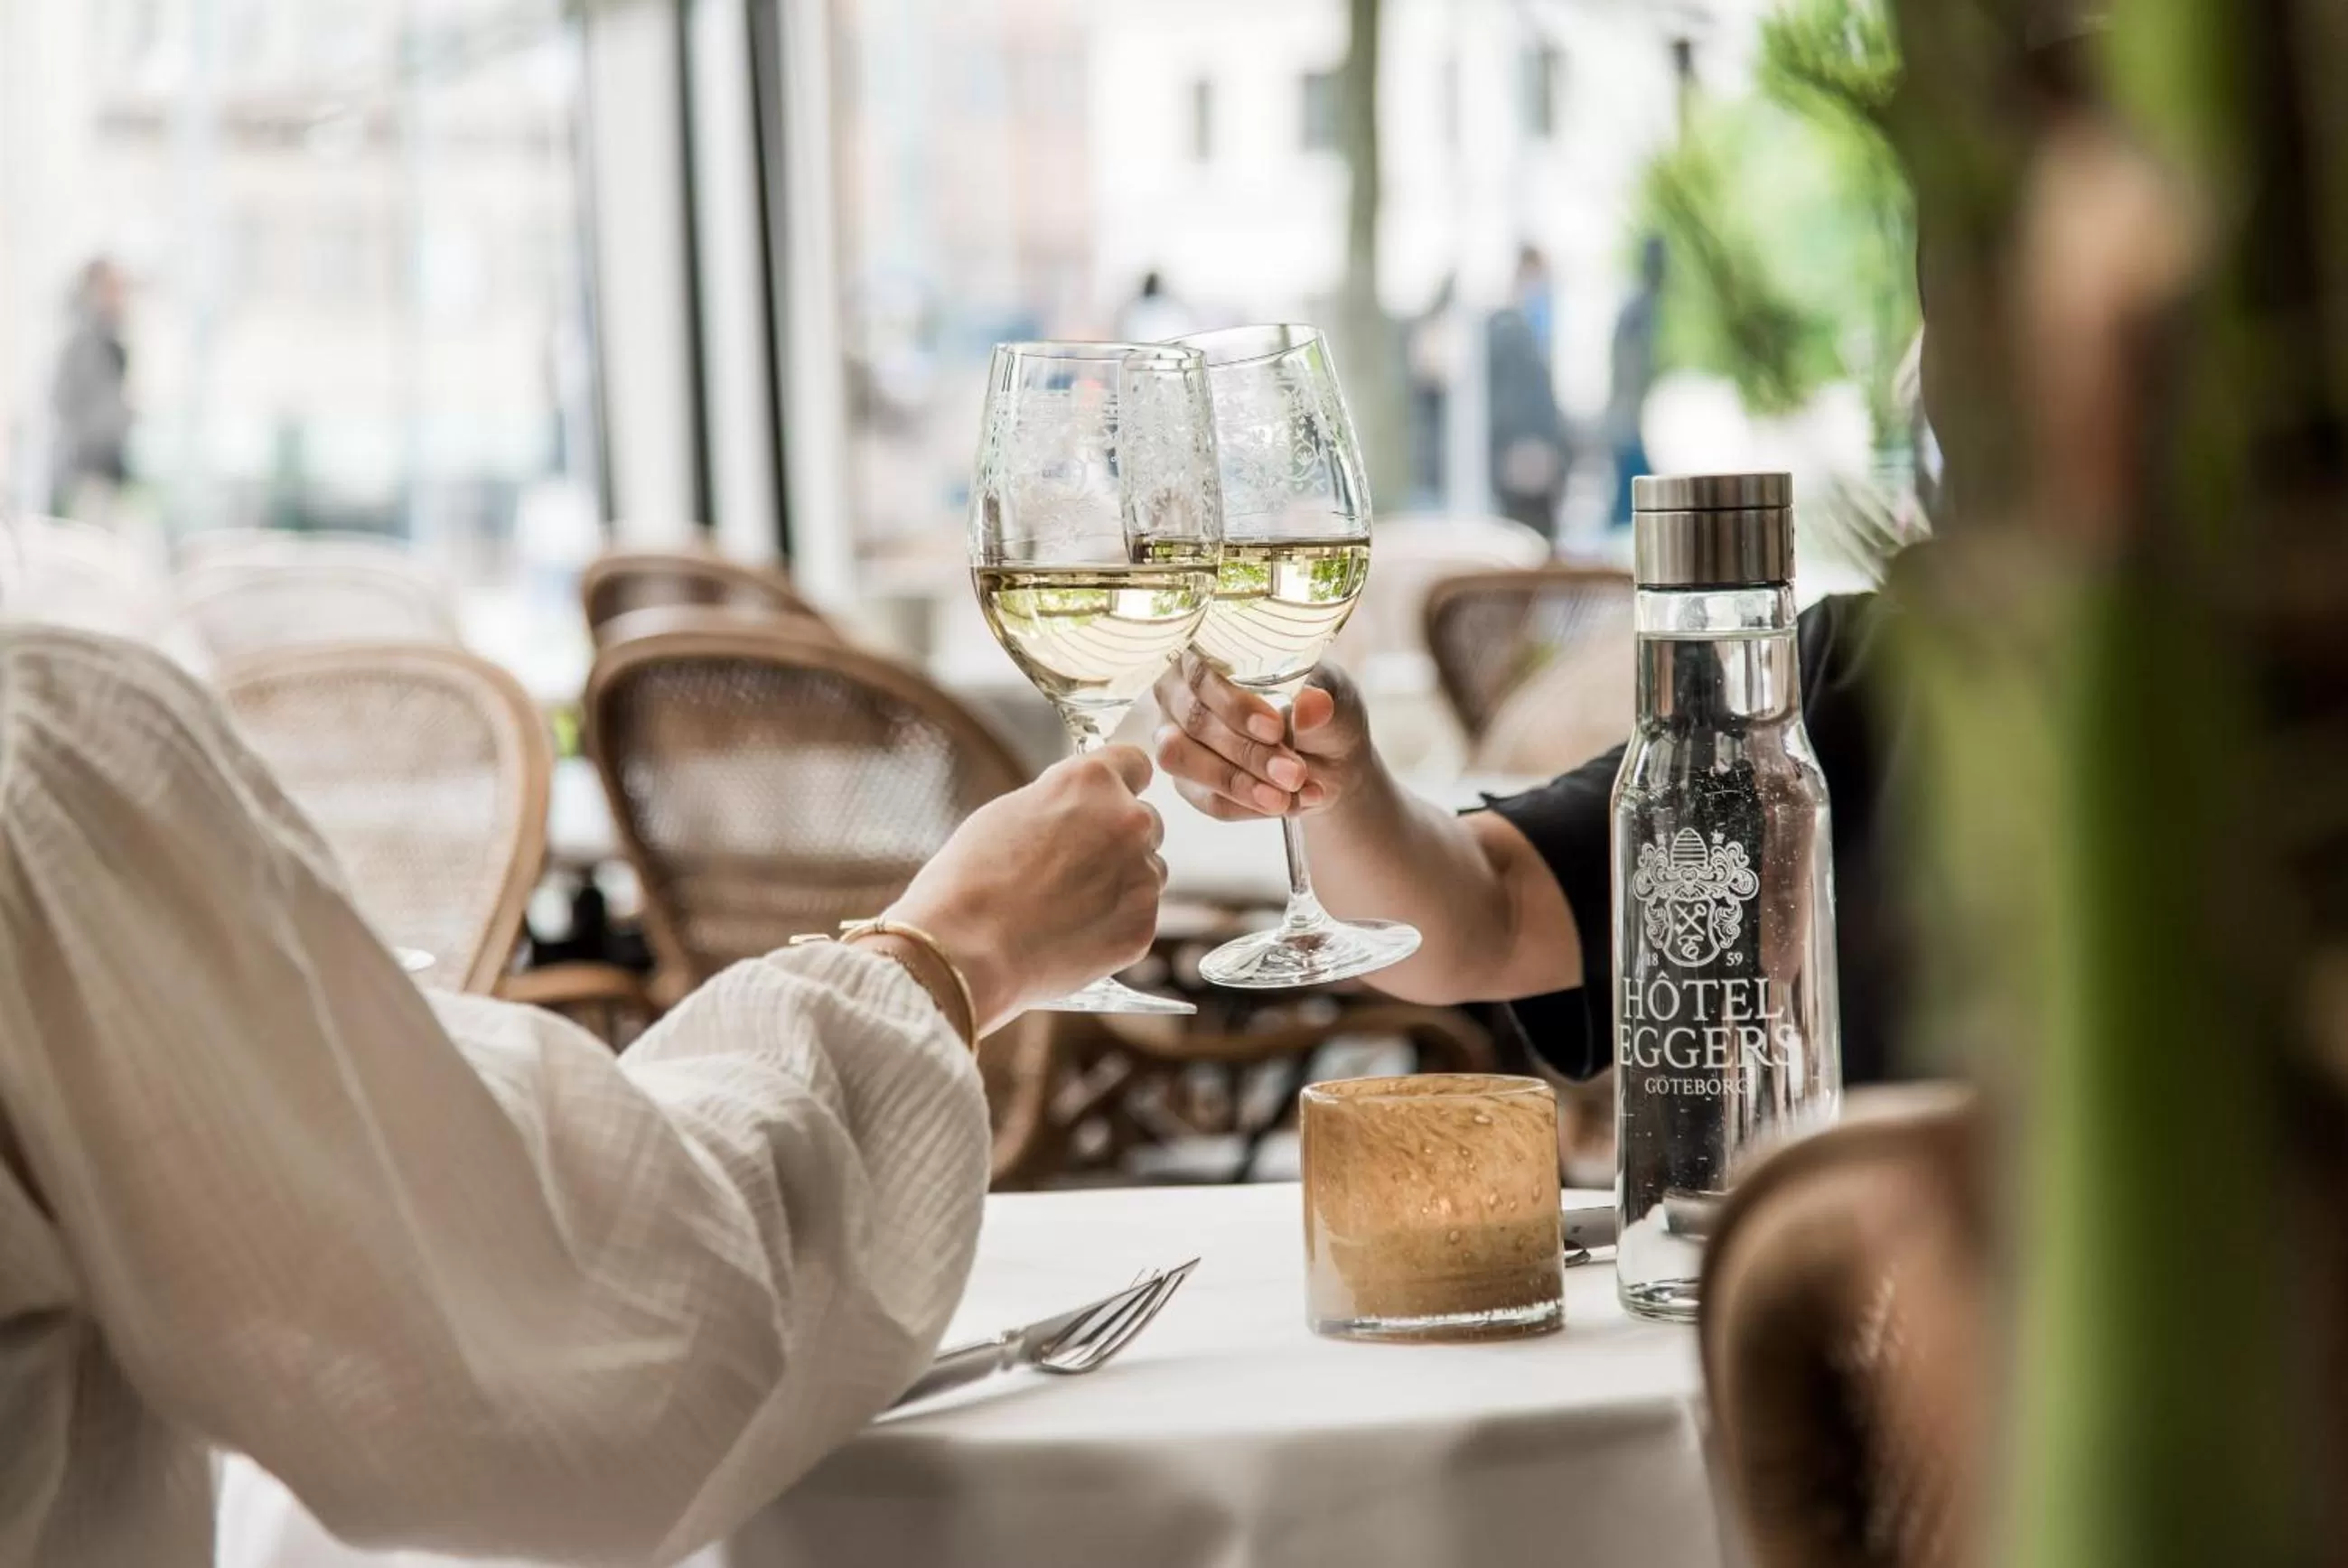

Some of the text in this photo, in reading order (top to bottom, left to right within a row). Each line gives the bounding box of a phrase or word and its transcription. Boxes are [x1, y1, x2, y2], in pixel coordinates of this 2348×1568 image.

[1726, 951, 1744, 967] 59
[1622, 970, 1785, 1022] HÔTEL
[1618, 1023, 1795, 1069] EGGERS
